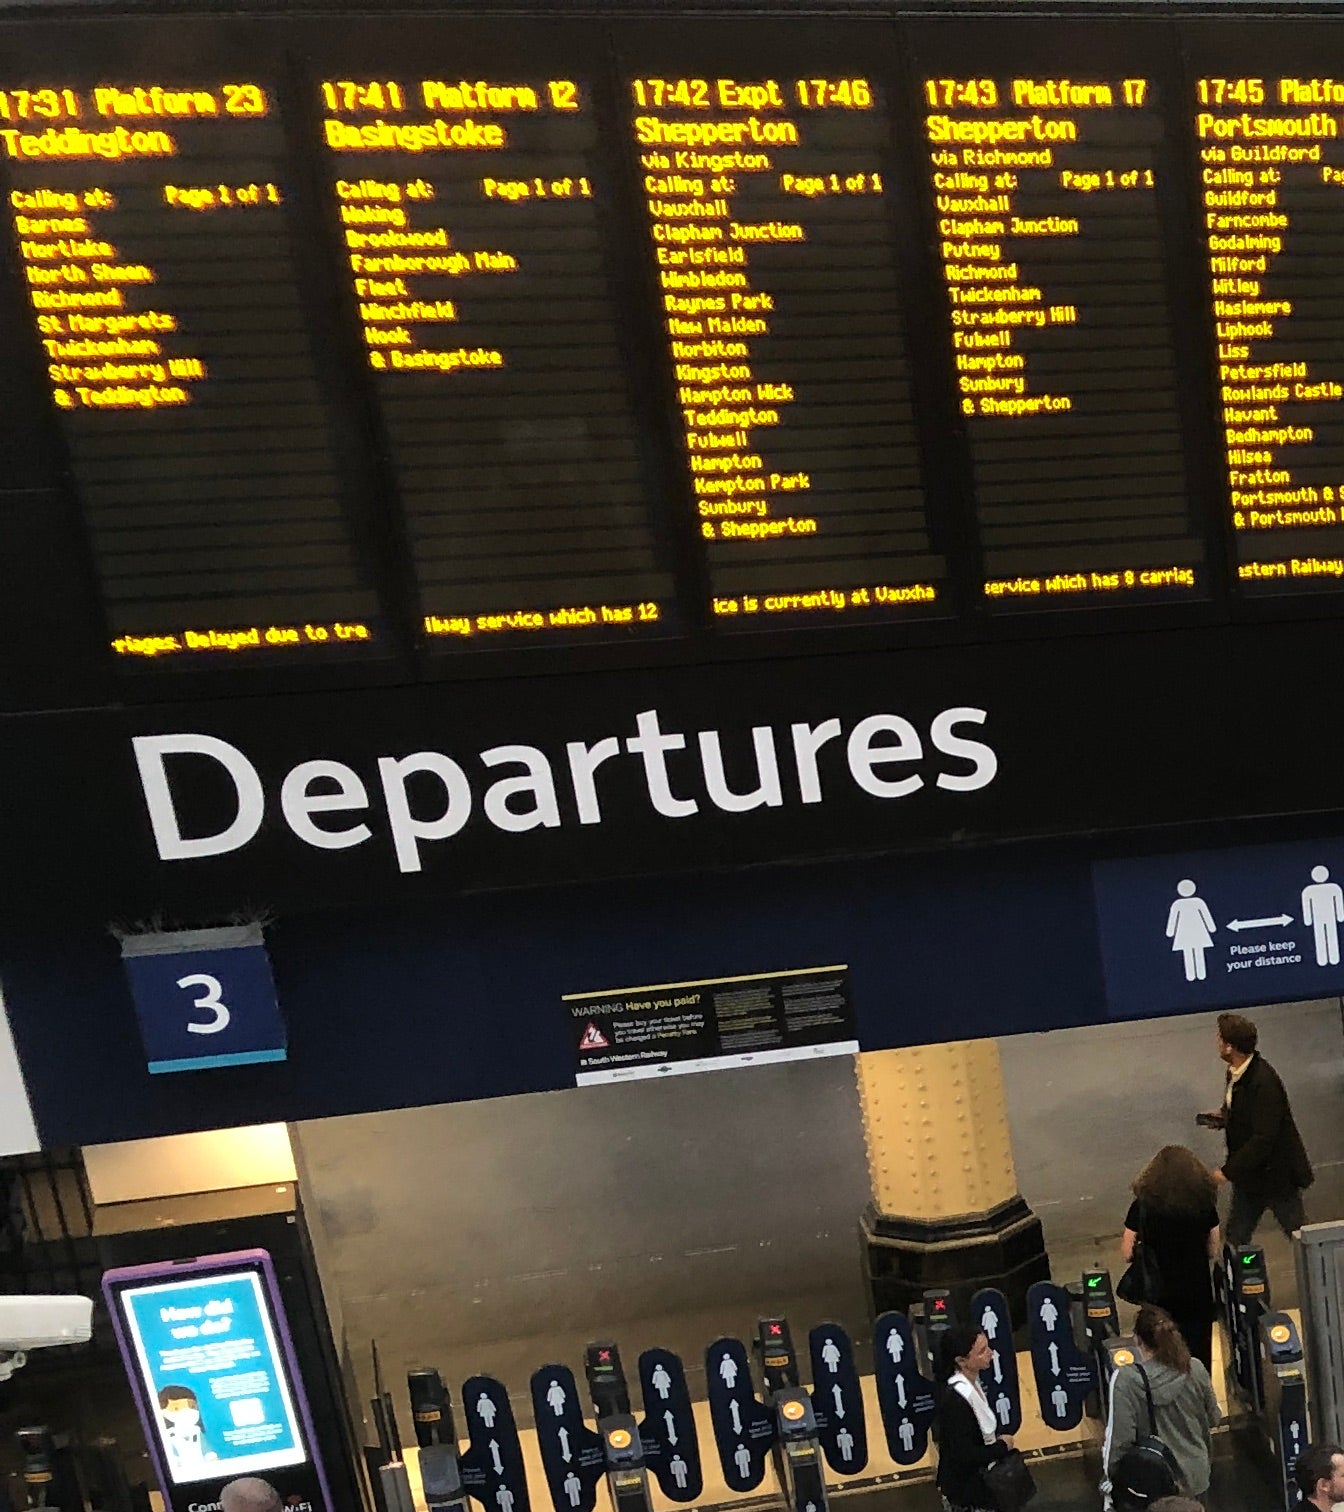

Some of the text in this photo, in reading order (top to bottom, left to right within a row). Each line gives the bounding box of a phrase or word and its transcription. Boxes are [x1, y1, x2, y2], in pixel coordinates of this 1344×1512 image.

[93, 86, 217, 116] Platform
[222, 84, 265, 117] 23
[321, 80, 578, 113] 17:41 Platform 12
[632, 79, 871, 110] 17:42 Expt 17:46
[925, 79, 1146, 107] 17:43 Platform 17
[1198, 78, 1265, 105] 17:45
[323, 118, 504, 152] Basingstoke
[635, 116, 797, 147] Shepperton
[926, 114, 1076, 145] Shepperton
[1197, 112, 1337, 138] Portsmouth
[0, 125, 173, 159] Teddington
[641, 150, 770, 173] via Kingston
[942, 241, 1001, 261] Putney
[1218, 343, 1250, 359] Liss
[698, 498, 767, 517] Sunbury
[131, 706, 999, 873] Departures
[1230, 941, 1296, 955] Please keep
[1226, 954, 1302, 973] your distance
[175, 974, 231, 1034] 3
[571, 994, 701, 1017] WARNING Have you paid?
[588, 1049, 668, 1066] South Western Railway
